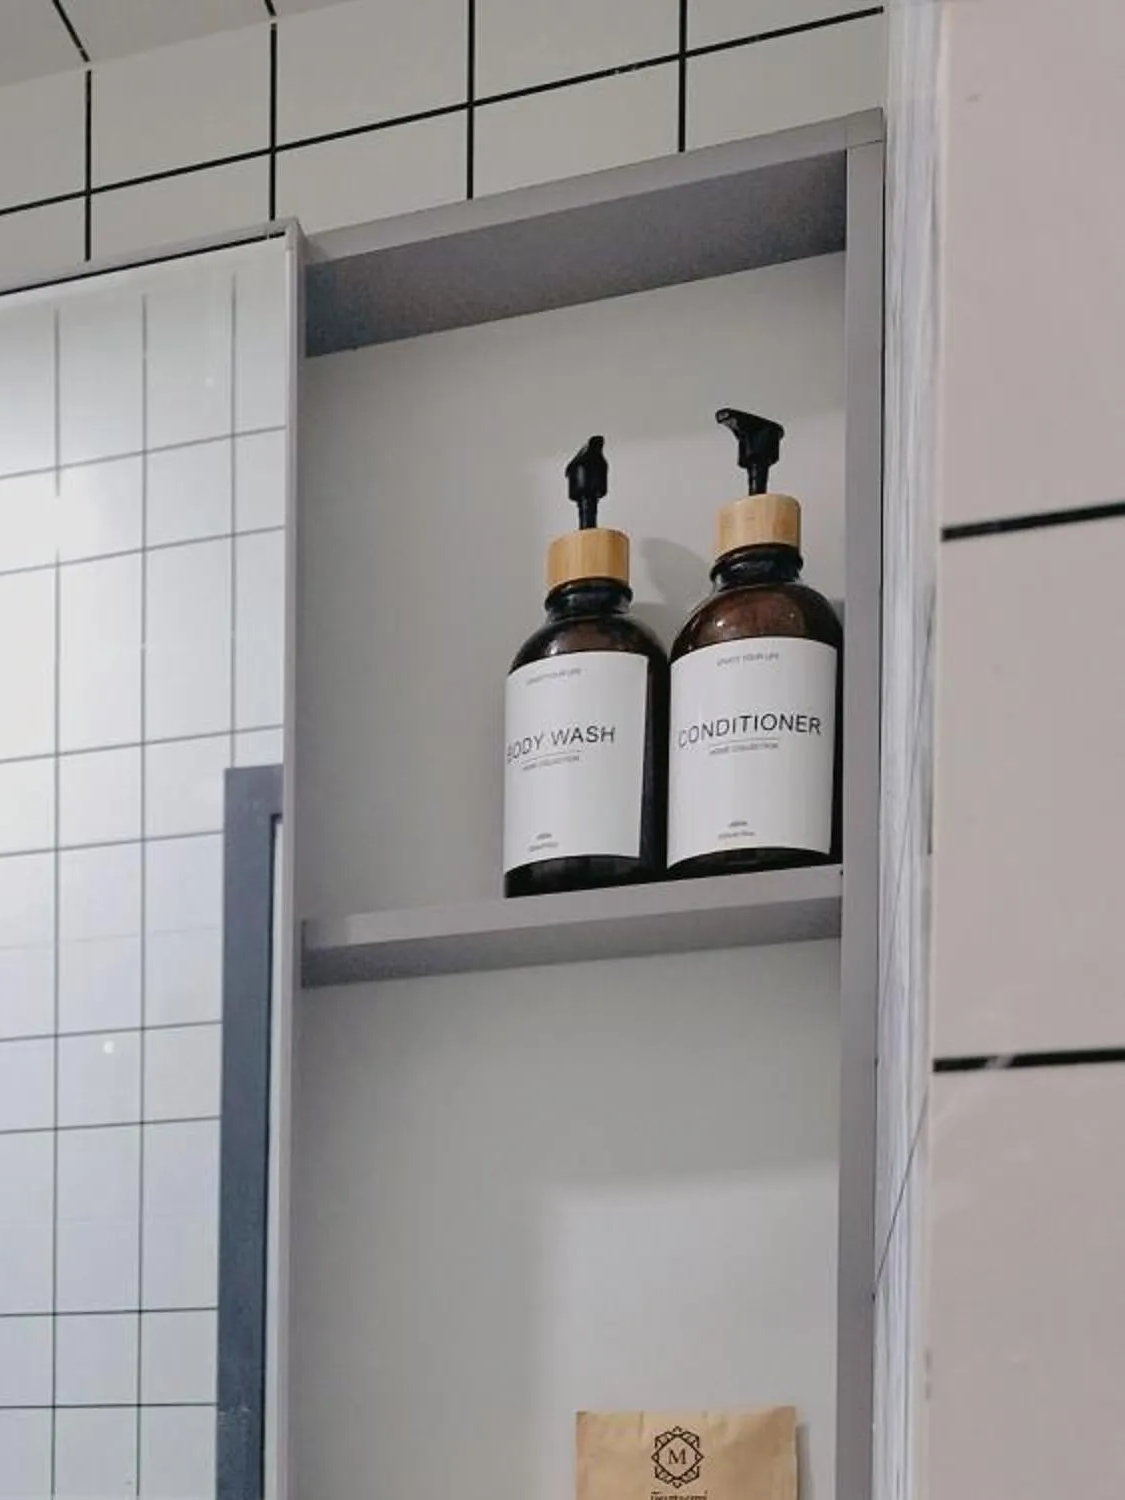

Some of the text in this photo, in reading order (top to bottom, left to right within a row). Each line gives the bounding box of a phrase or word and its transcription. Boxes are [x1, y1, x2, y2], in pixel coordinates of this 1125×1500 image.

[551, 725, 616, 746] WASH
[678, 713, 821, 748] CONDITIONER
[668, 1449, 687, 1465] M
